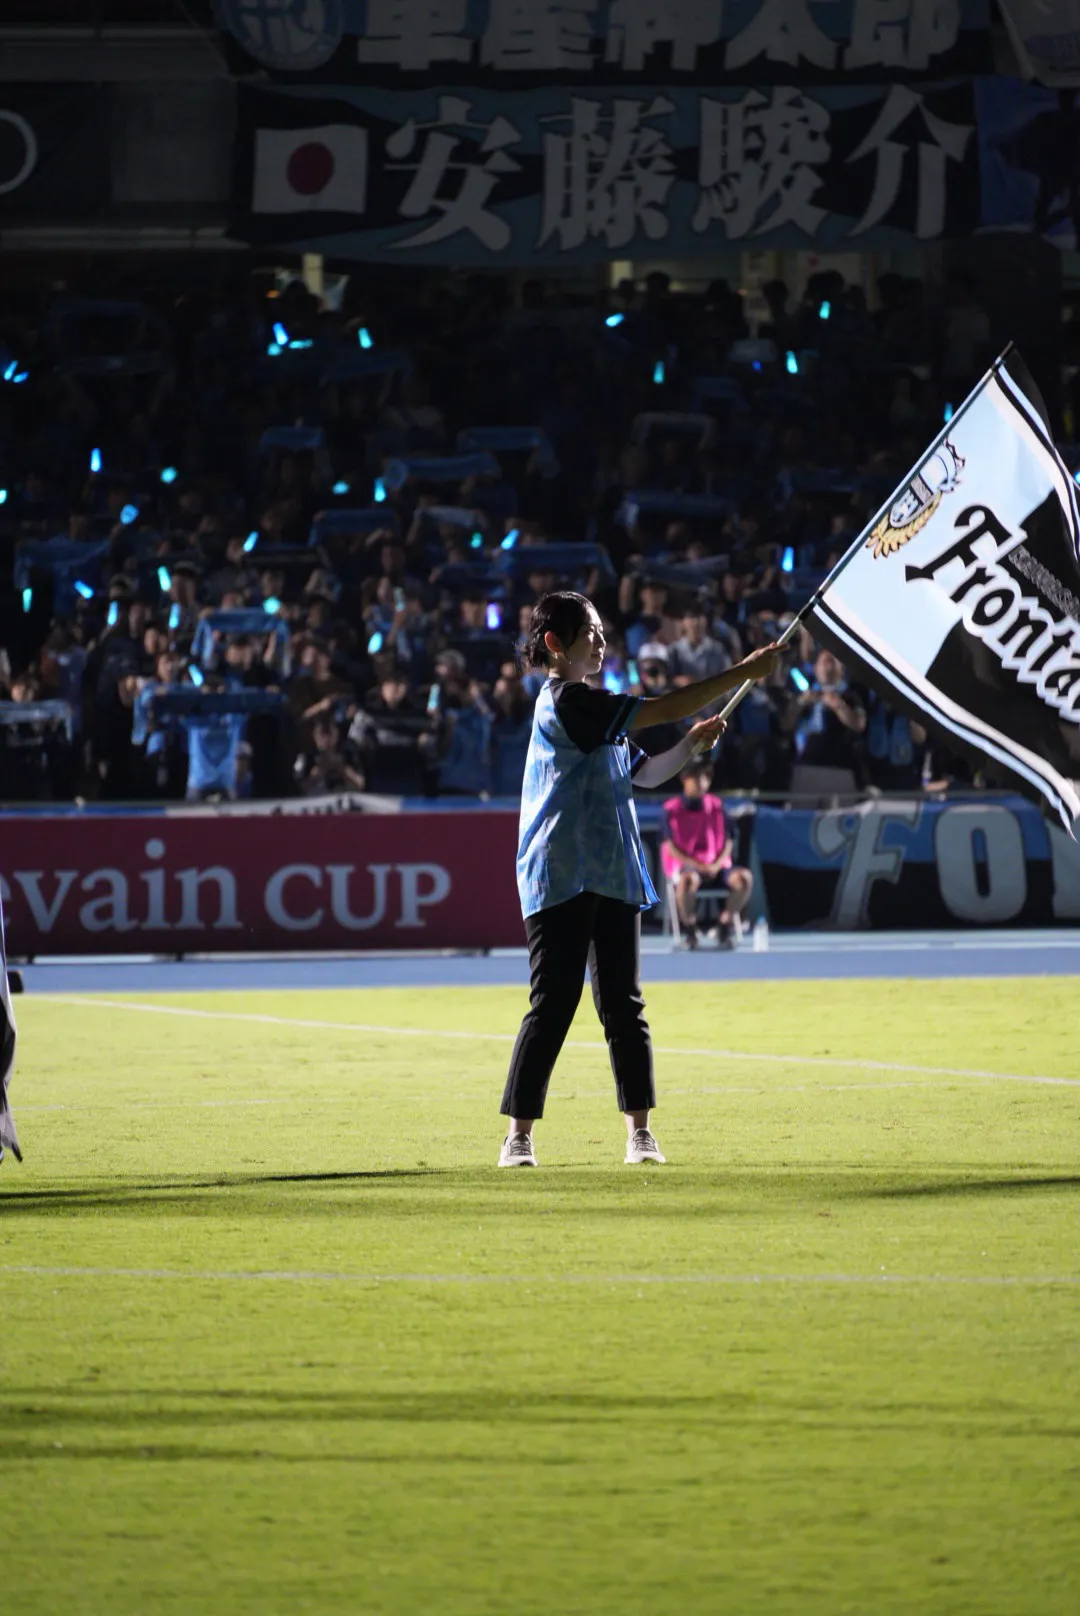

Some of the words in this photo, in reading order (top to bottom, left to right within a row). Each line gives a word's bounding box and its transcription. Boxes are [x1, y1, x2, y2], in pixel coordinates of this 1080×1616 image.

[385, 84, 976, 251] 安藤駿介
[905, 505, 1080, 710] Fronta
[265, 863, 451, 931] CUP
